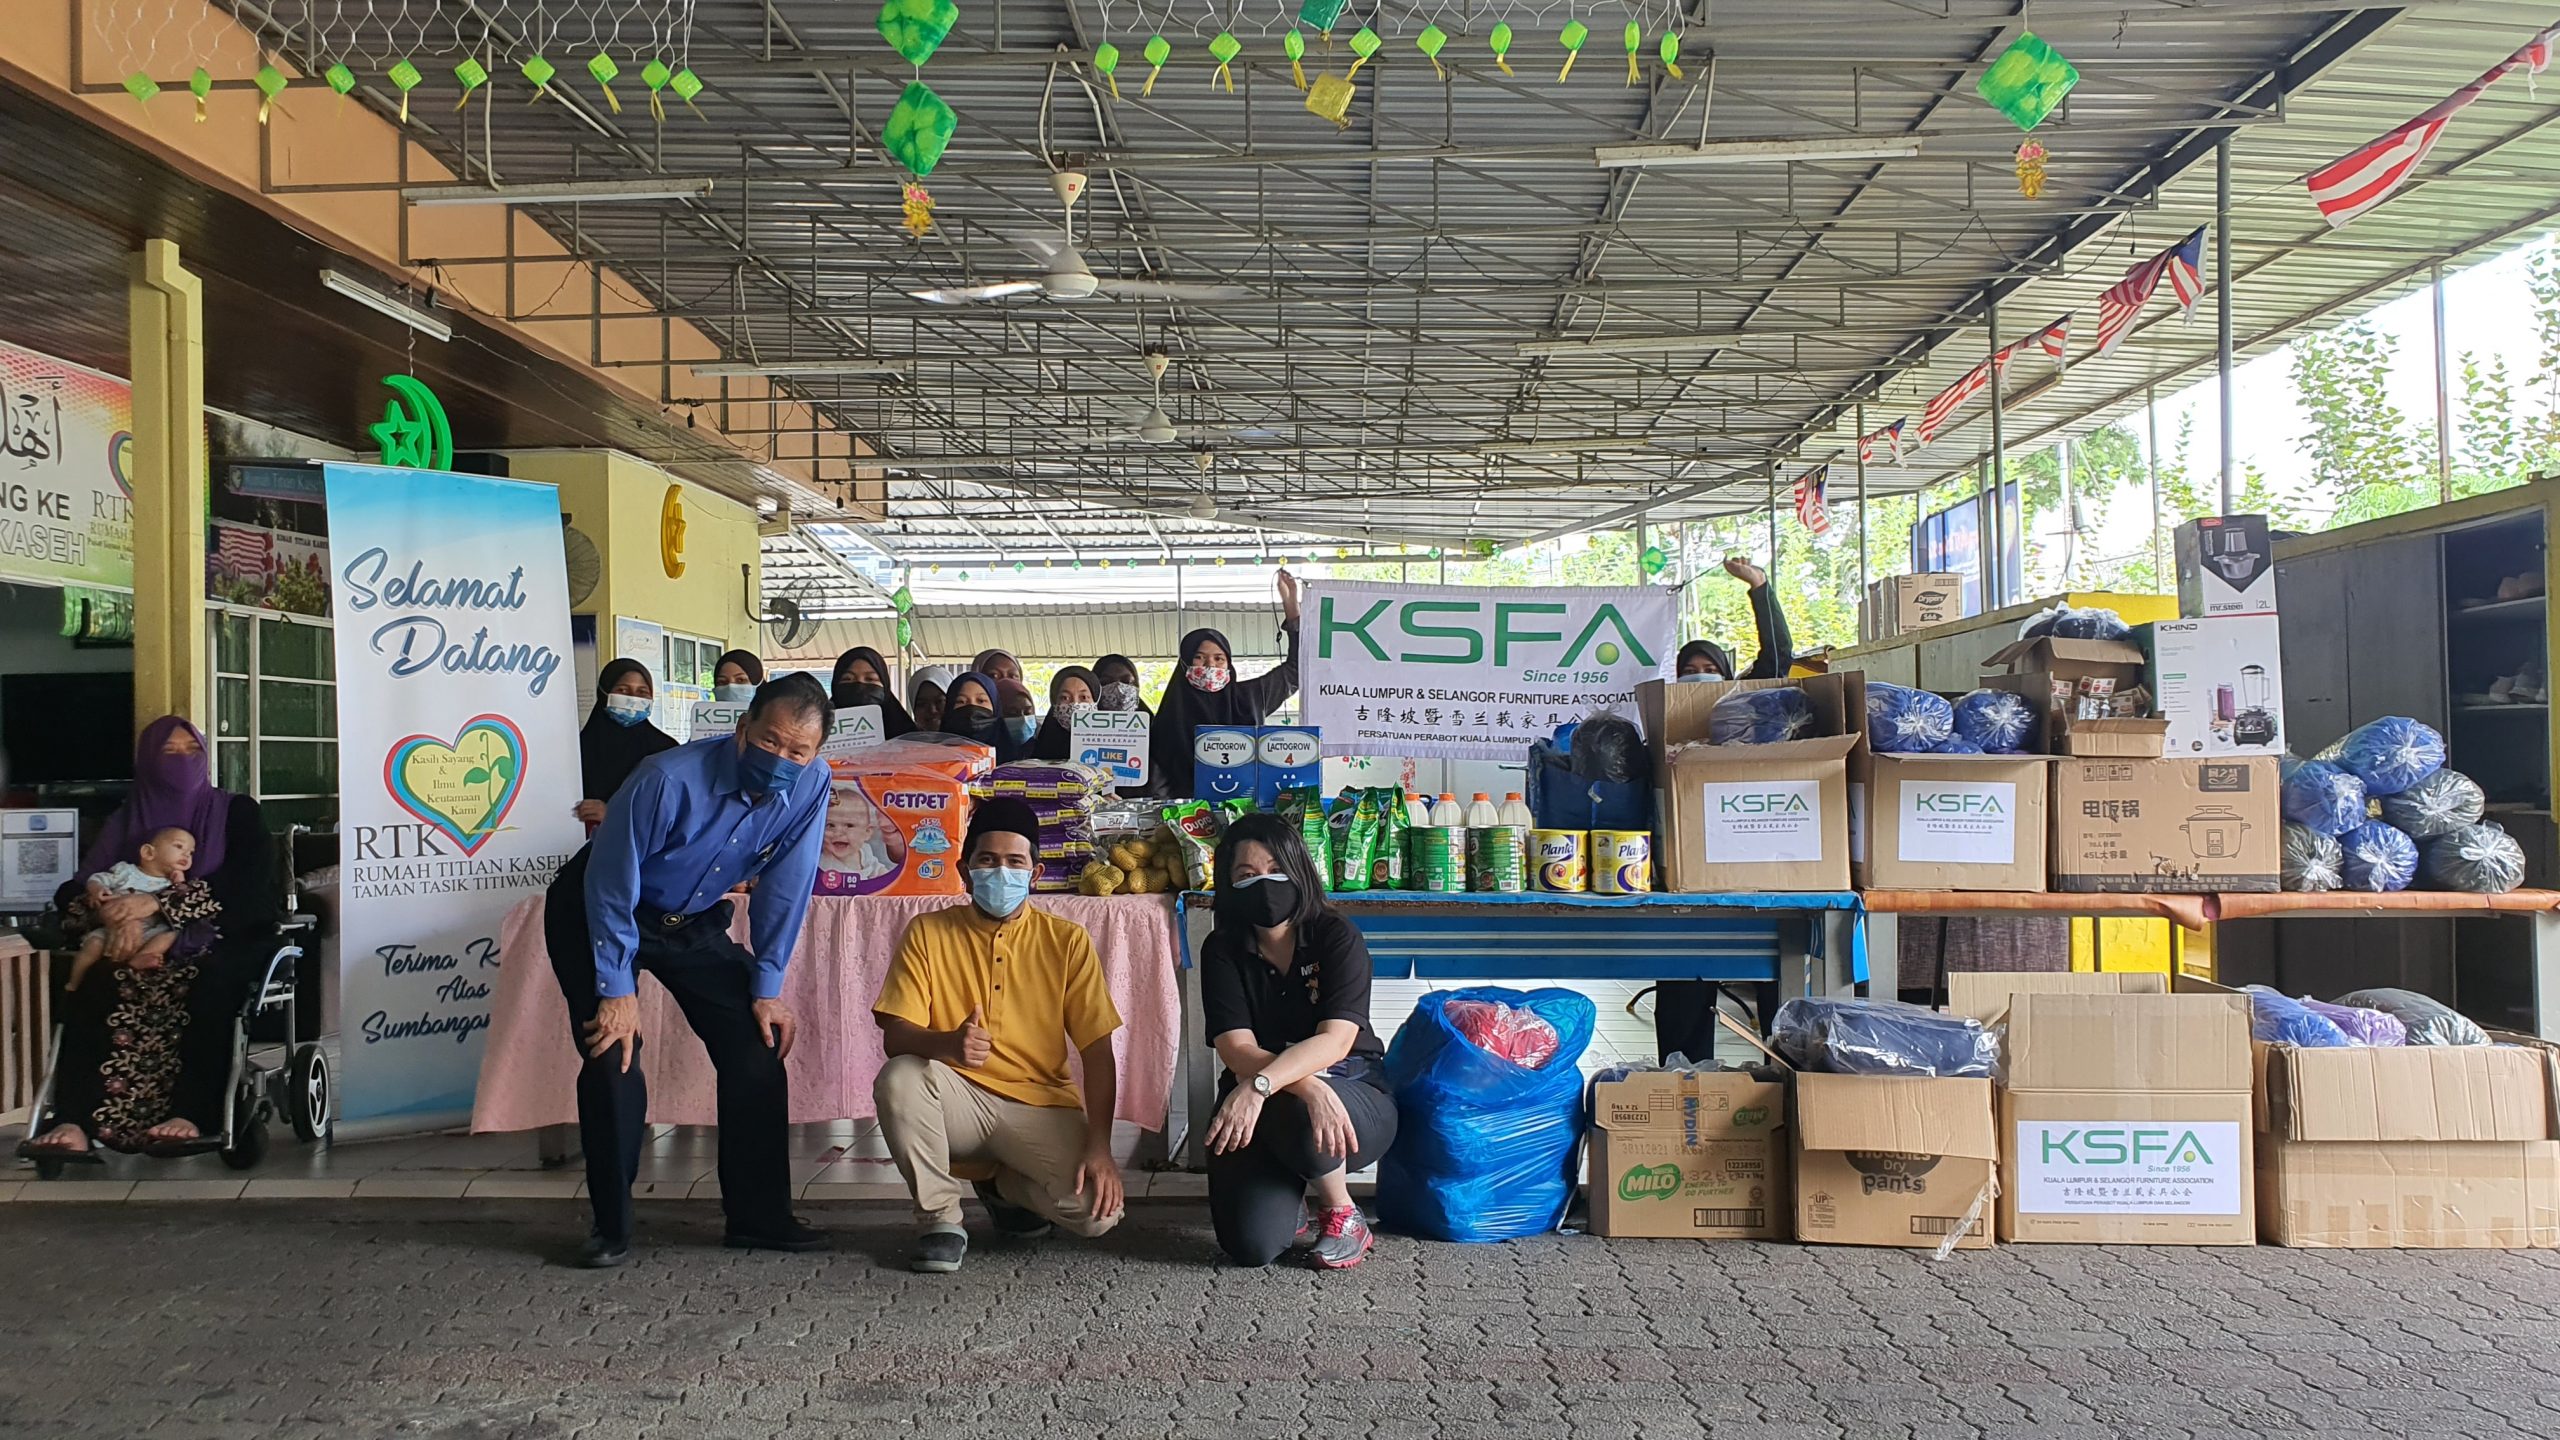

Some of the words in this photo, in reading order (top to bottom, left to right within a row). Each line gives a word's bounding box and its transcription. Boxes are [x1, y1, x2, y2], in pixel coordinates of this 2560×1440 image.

[37, 489, 70, 521] KE
[343, 547, 526, 611] Selamat
[1318, 596, 1657, 668] KSFA
[2160, 623, 2198, 631] KHIND
[370, 615, 561, 697] Datang
[1522, 670, 1566, 683] Since
[1572, 671, 1609, 684] 1956
[1319, 684, 1360, 697] KUALA
[1362, 687, 1413, 700] LUMPUR
[1416, 688, 1425, 699] &
[1428, 689, 1495, 703] SELANGOR
[1499, 692, 1570, 705] FURNITURE
[1573, 692, 1637, 704] ASSOCIAT
[1073, 712, 1147, 729] KSFA
[1357, 729, 1412, 740] PERSATUAN
[1413, 732, 1458, 742] PERABOT
[1459, 734, 1491, 743] KUALA
[1492, 735, 1531, 745] LUMPUR
[1204, 742, 1247, 751] LACTOGROW
[1267, 742, 1311, 752] LACTOGROW
[412, 754, 439, 764] Kasih
[442, 754, 475, 765] Sayang
[1101, 751, 1123, 760] LIKE
[1220, 753, 1229, 765] 3
[1284, 753, 1294, 765] 4
[438, 766, 448, 775] &
[433, 780, 455, 789] Ilmu
[427, 793, 481, 804] Keutamaan
[883, 792, 949, 809] PETPET
[1721, 793, 1809, 813] KSFA
[1916, 793, 2004, 813] KSFA
[451, 805, 477, 816] Kami
[2082, 800, 2140, 819] 电饭锅
[353, 822, 449, 861] RTK
[1540, 843, 1574, 856] Planta
[1618, 844, 1649, 857] Planta
[354, 863, 431, 883] RUMAH
[436, 858, 503, 877] TITIAN
[509, 855, 569, 873] KASEH
[828, 872, 836, 882] S
[352, 881, 421, 899] TAMAN
[420, 878, 470, 894] TASIK
[376, 944, 458, 977] Terima
[436, 974, 491, 1003] Atas
[2041, 1129, 2214, 1164] KSFA
[1883, 1159, 1907, 1172] Dry
[1627, 1174, 1676, 1192] MILO
[1863, 1174, 1924, 1193] pants
[1815, 1195, 1827, 1203] UP
